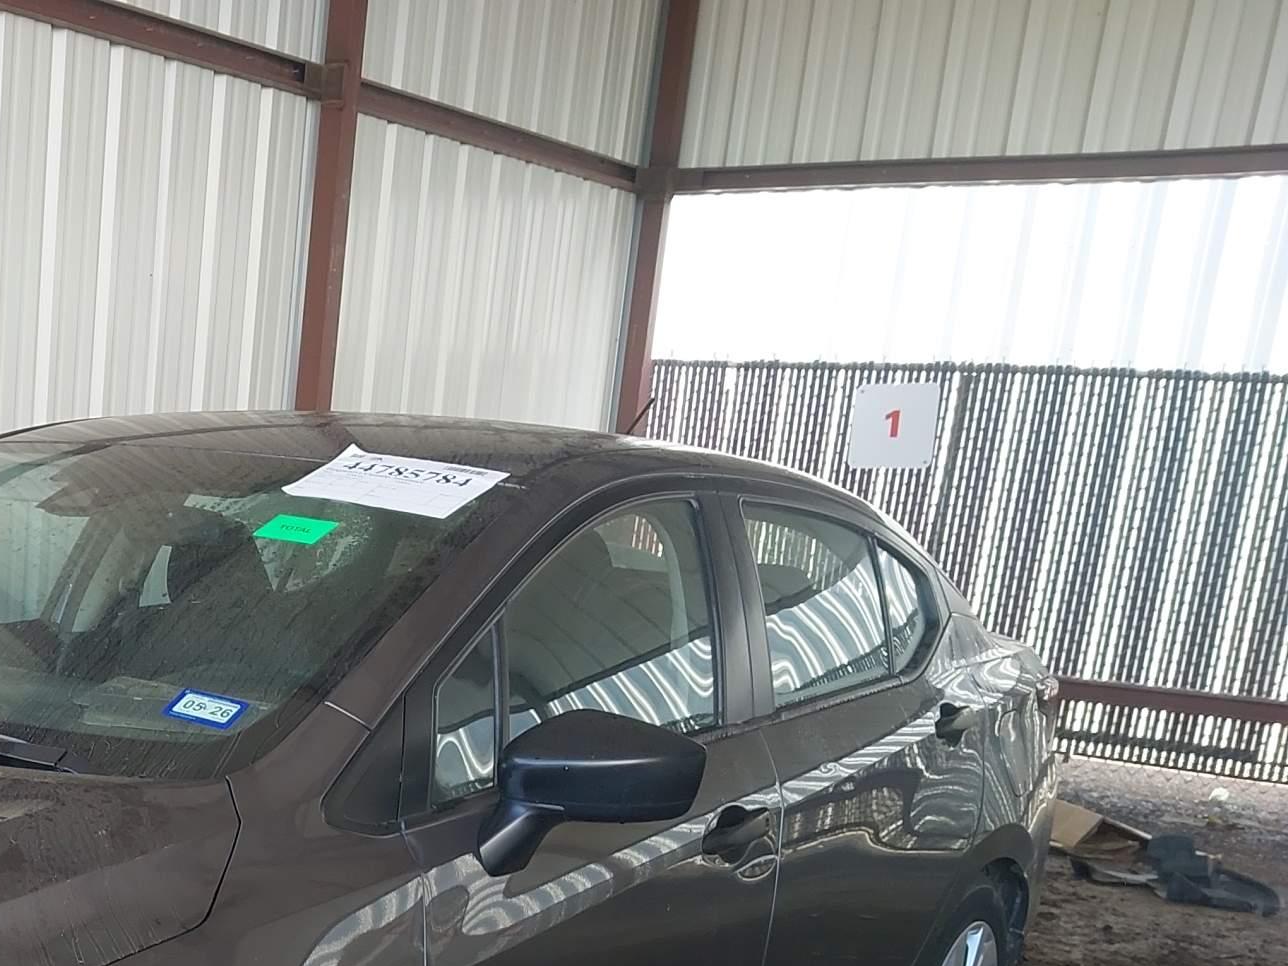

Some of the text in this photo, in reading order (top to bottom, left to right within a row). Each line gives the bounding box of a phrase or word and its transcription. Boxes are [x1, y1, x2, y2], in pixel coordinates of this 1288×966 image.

[884, 409, 902, 438] 1
[343, 460, 473, 487] 44785784
[279, 523, 313, 534] TOTAL
[182, 699, 203, 712] 05
[208, 705, 234, 719] 26
